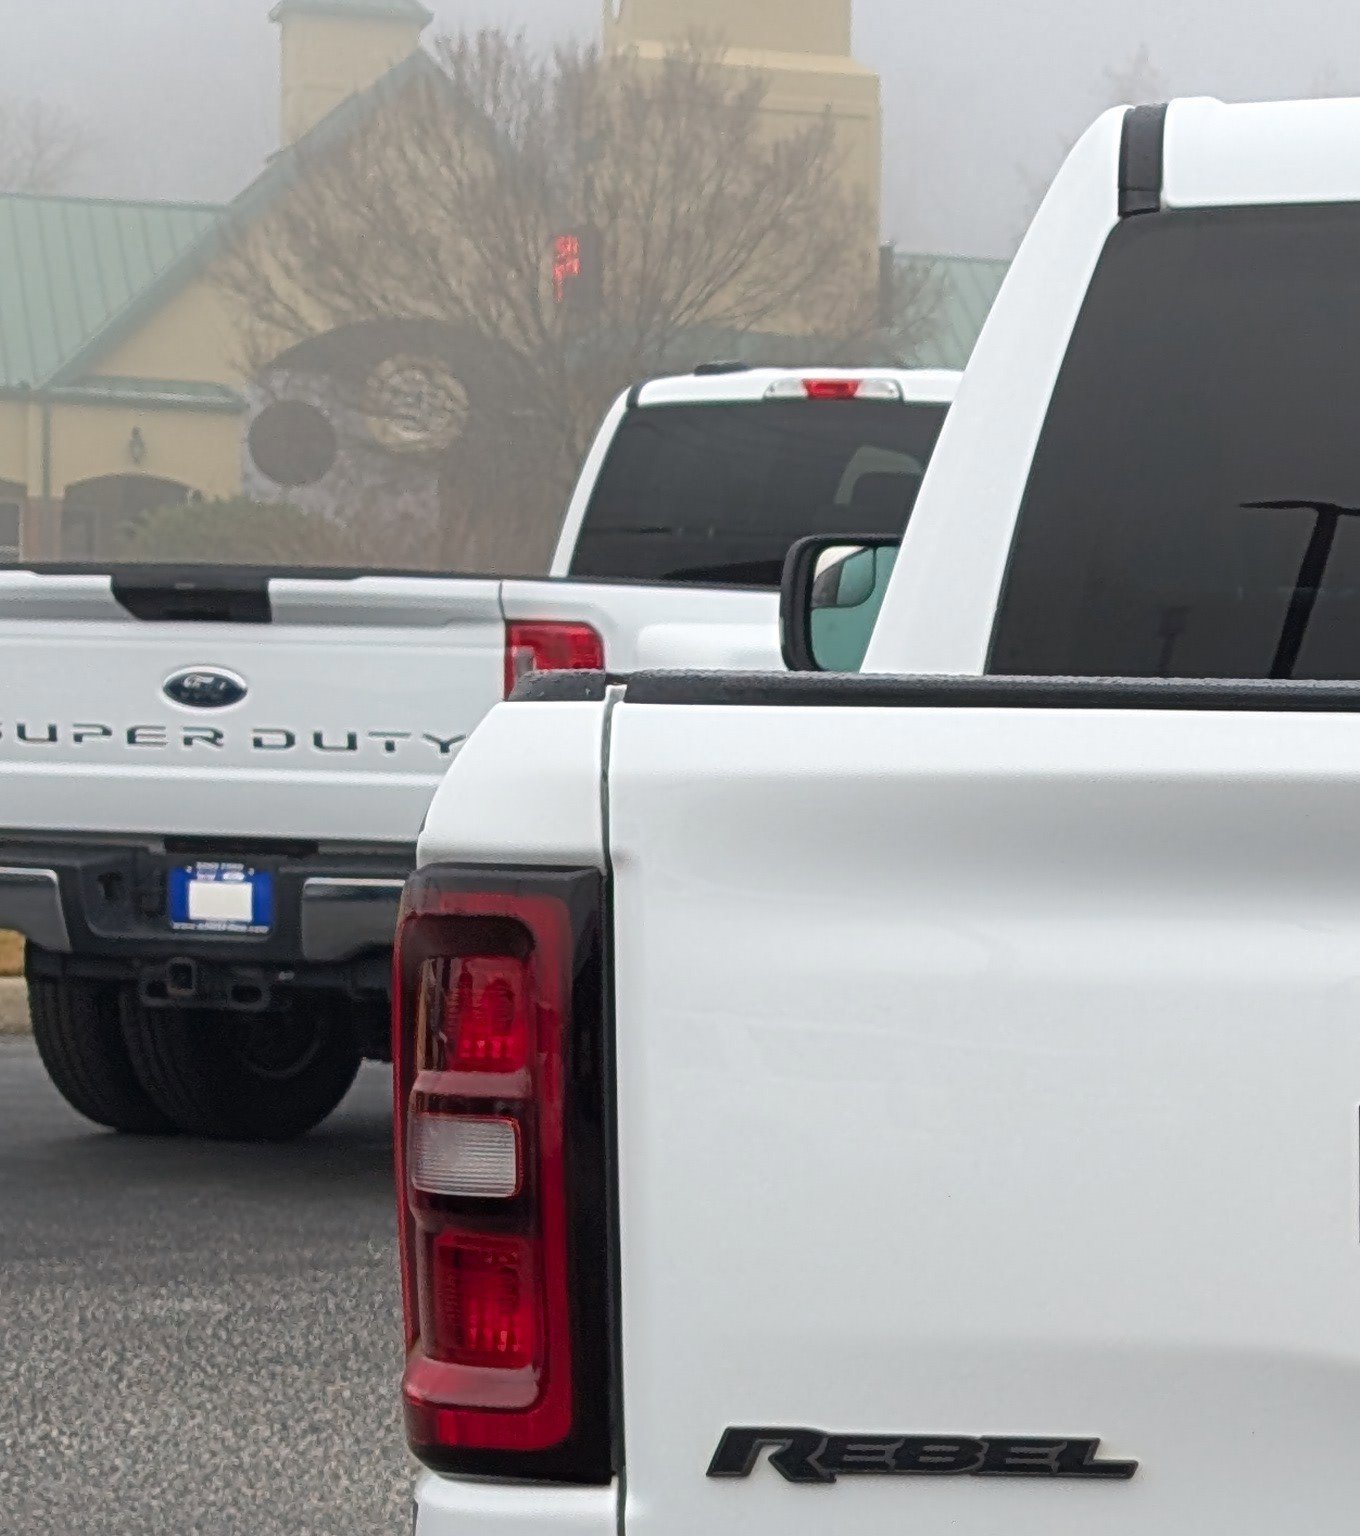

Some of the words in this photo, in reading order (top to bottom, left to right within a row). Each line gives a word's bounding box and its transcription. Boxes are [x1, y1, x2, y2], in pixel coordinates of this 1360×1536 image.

[0, 722, 225, 748] UPER
[252, 728, 468, 754] DUTY
[706, 1426, 1139, 1483] REBEL
